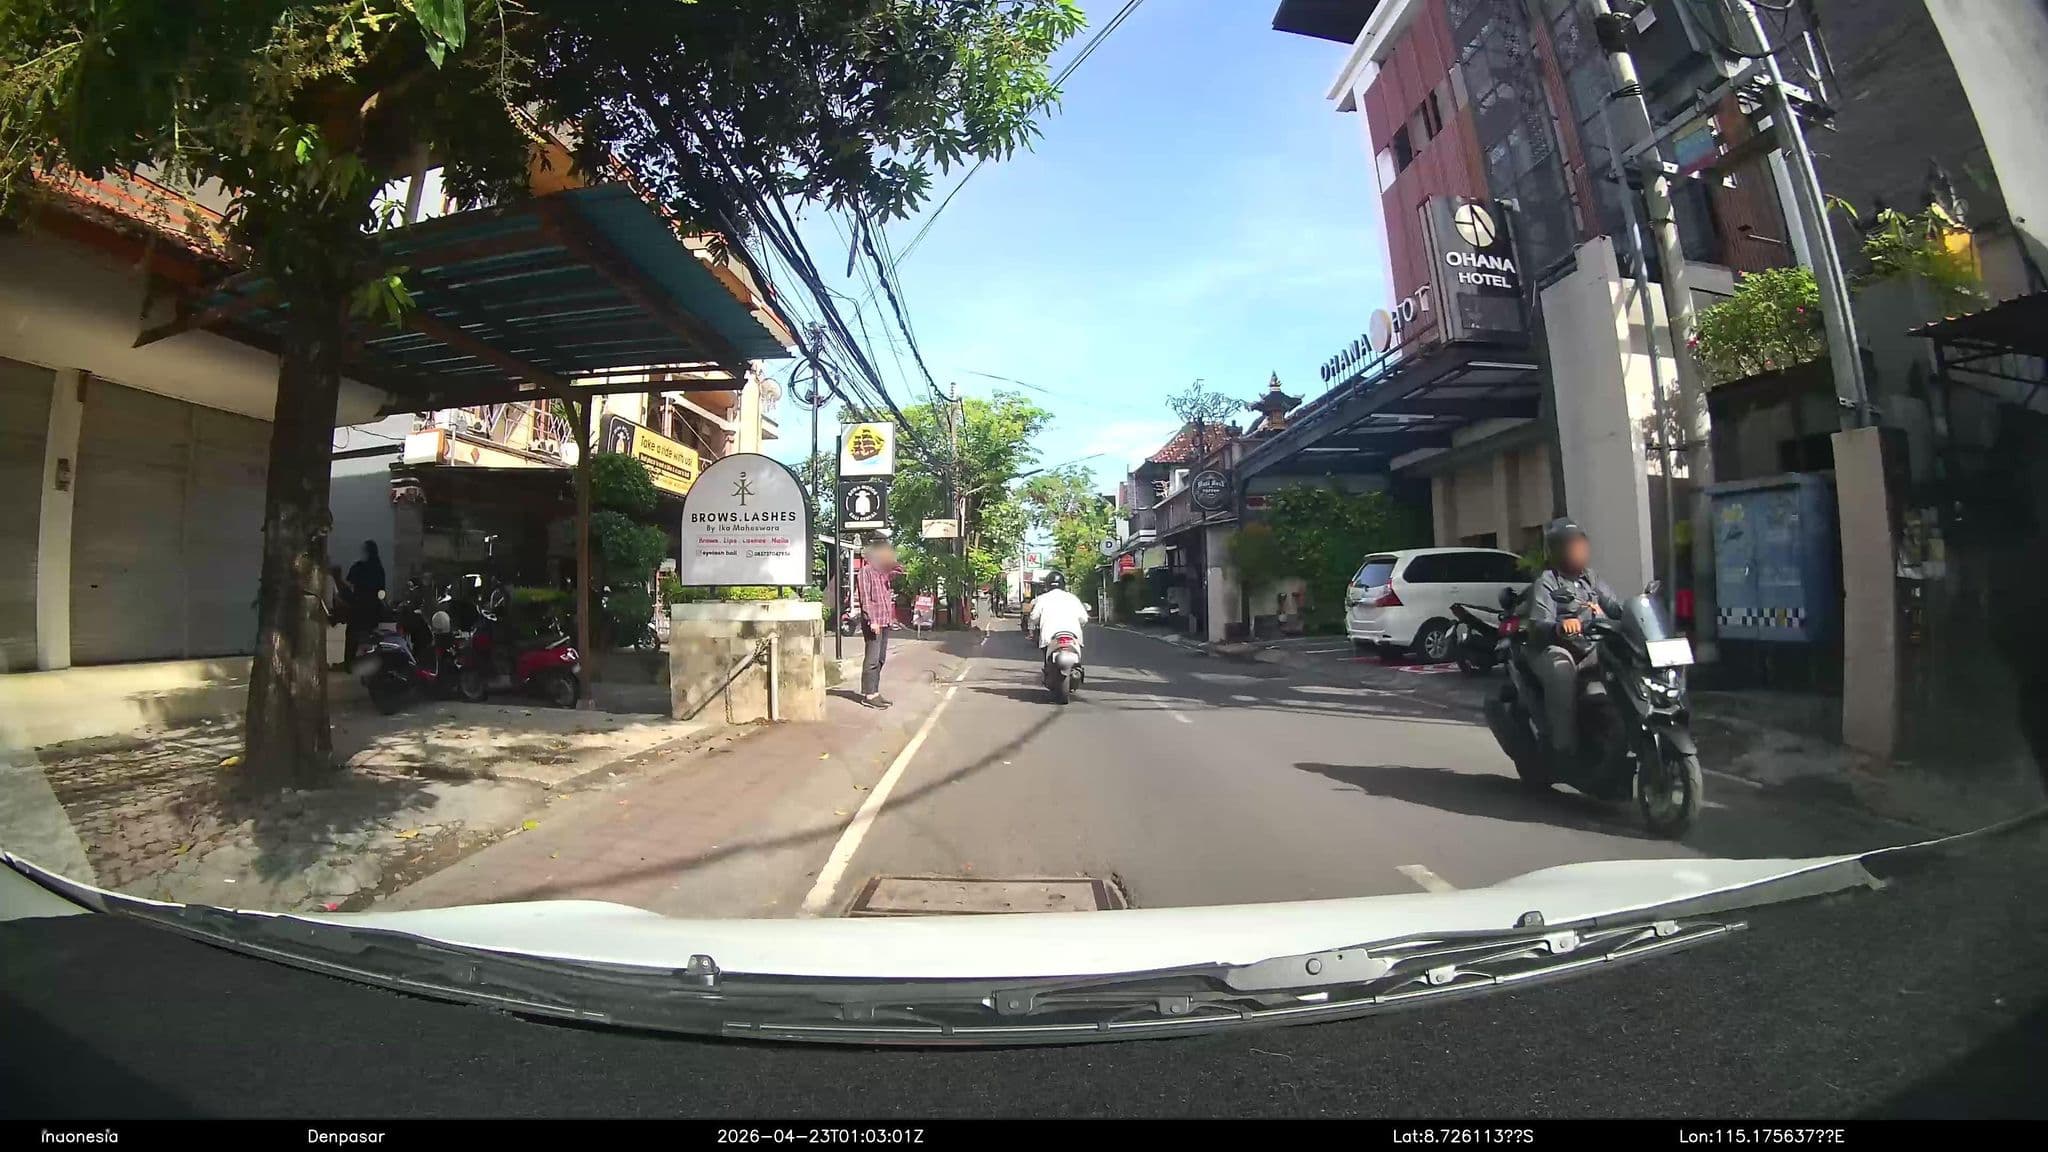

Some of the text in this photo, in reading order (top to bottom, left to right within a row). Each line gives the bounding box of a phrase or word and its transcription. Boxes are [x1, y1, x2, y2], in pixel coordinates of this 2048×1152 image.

[1446, 251, 1516, 274] OHANA
[1458, 271, 1512, 288] HOTEL
[1320, 333, 1373, 382] OHANA
[691, 511, 796, 523] BROWS.LASHES
[706, 525, 716, 533] By
[732, 524, 780, 532] Maheswara
